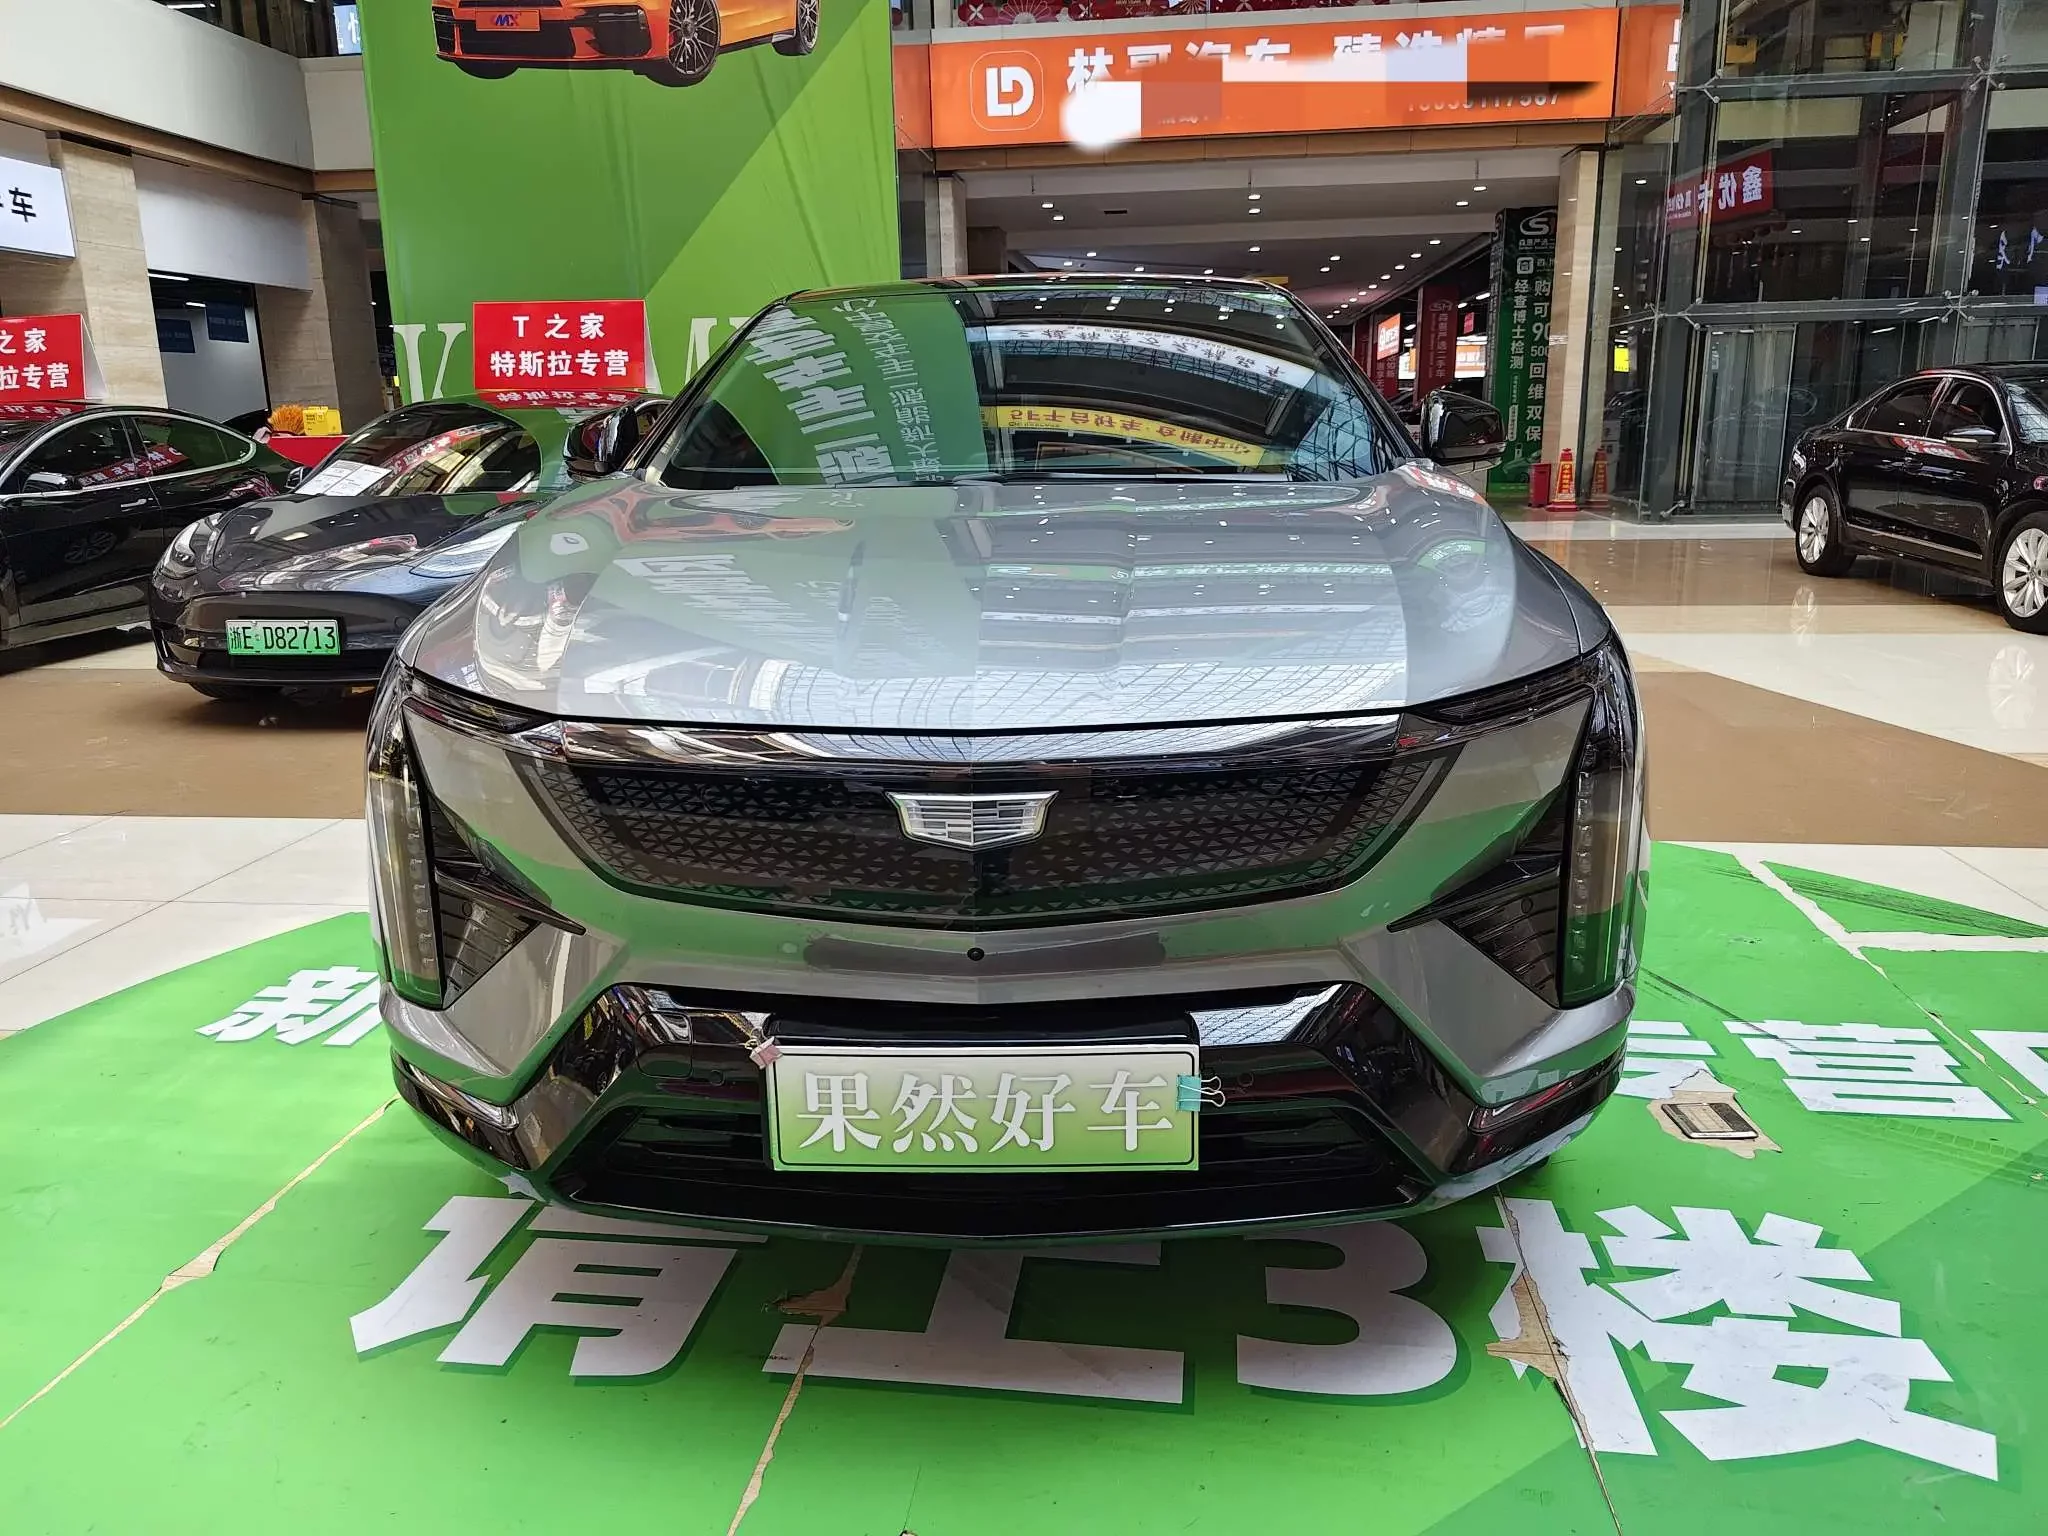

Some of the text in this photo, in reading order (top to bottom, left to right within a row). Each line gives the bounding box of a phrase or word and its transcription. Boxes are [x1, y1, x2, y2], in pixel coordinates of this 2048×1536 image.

[0, 187, 37, 223] 车
[1509, 279, 1529, 369] 经查博士检测
[0, 362, 70, 390] 拉专营
[490, 349, 630, 378] 特斯拉专营
[796, 1069, 1175, 1154] 果然好车
